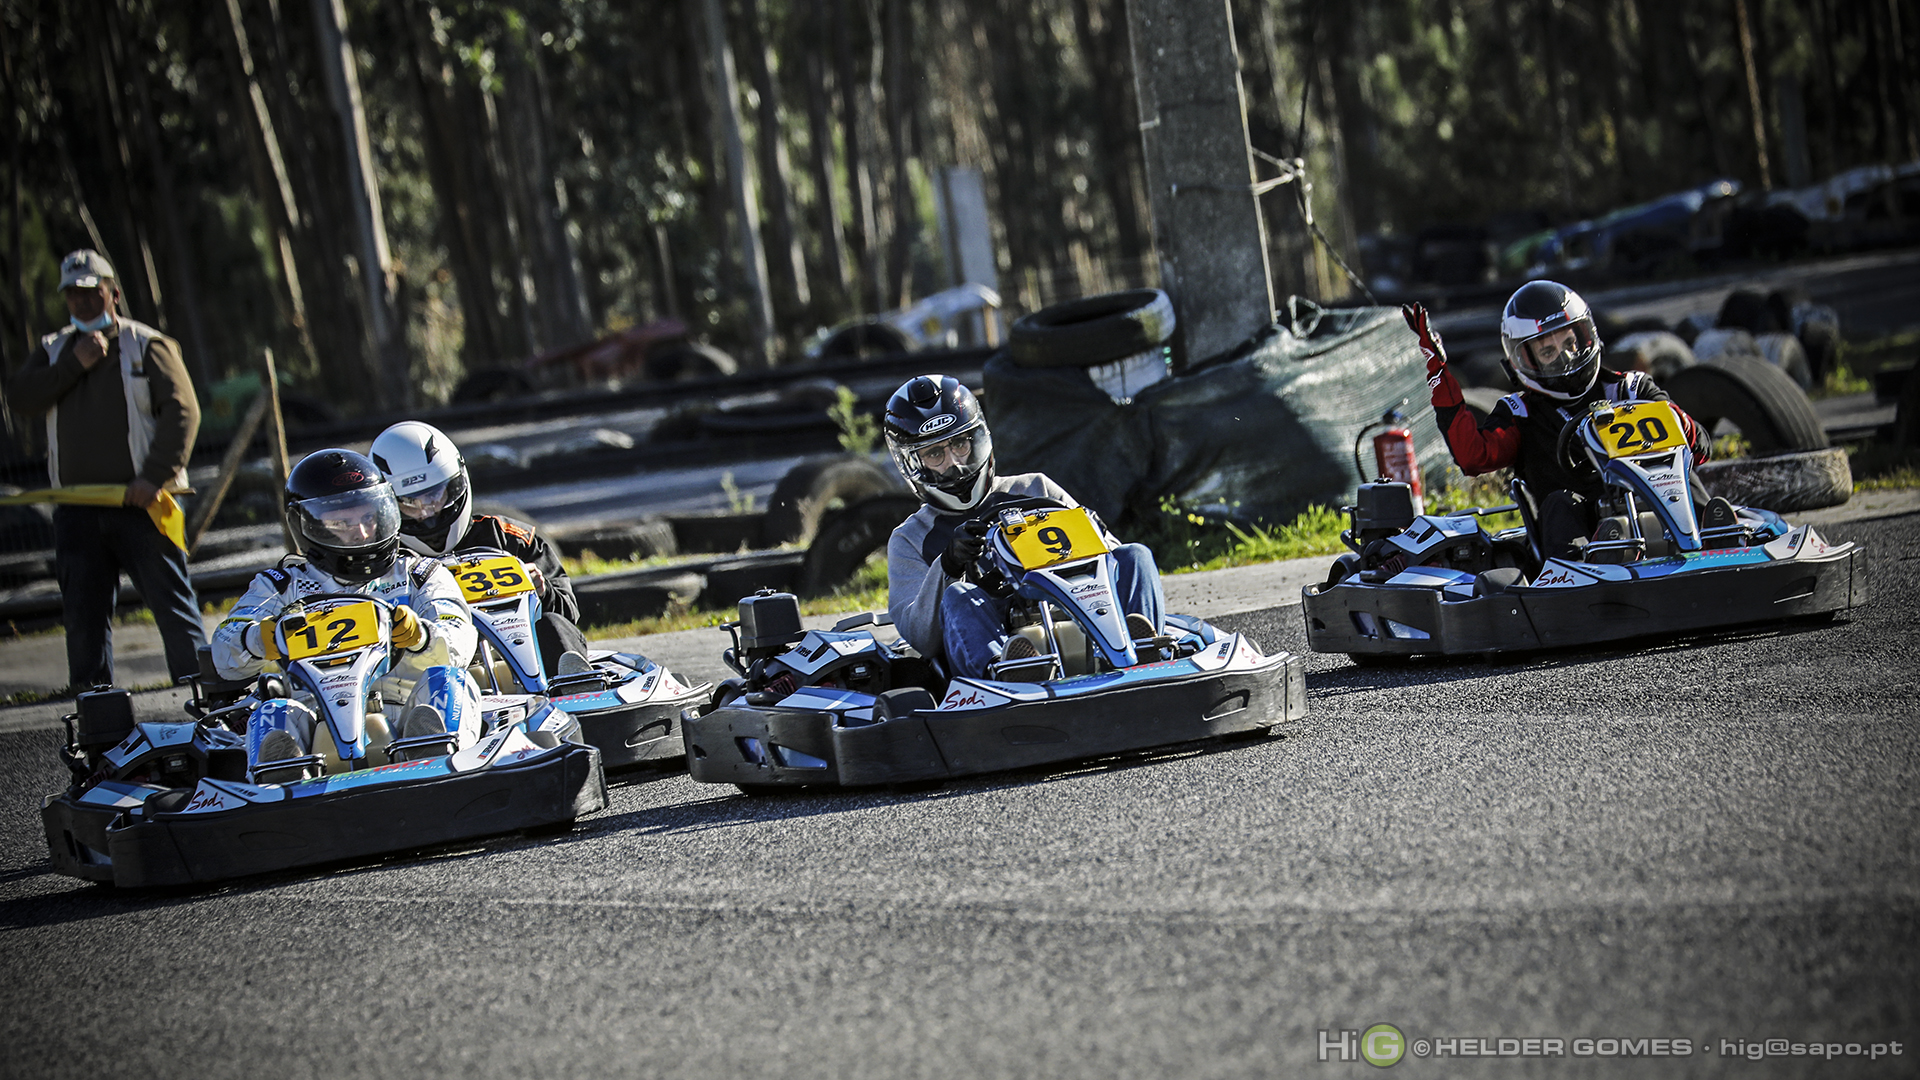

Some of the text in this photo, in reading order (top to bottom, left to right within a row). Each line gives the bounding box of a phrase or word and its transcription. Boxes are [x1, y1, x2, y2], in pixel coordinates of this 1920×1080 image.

[925, 416, 950, 431] HJC
[1609, 417, 1668, 449] 20
[1037, 526, 1073, 554] 9
[460, 566, 523, 593] 35
[1536, 569, 1576, 587] Sodi
[294, 618, 359, 650] 12
[942, 690, 986, 710] Sodi
[187, 790, 224, 812] Sodi
